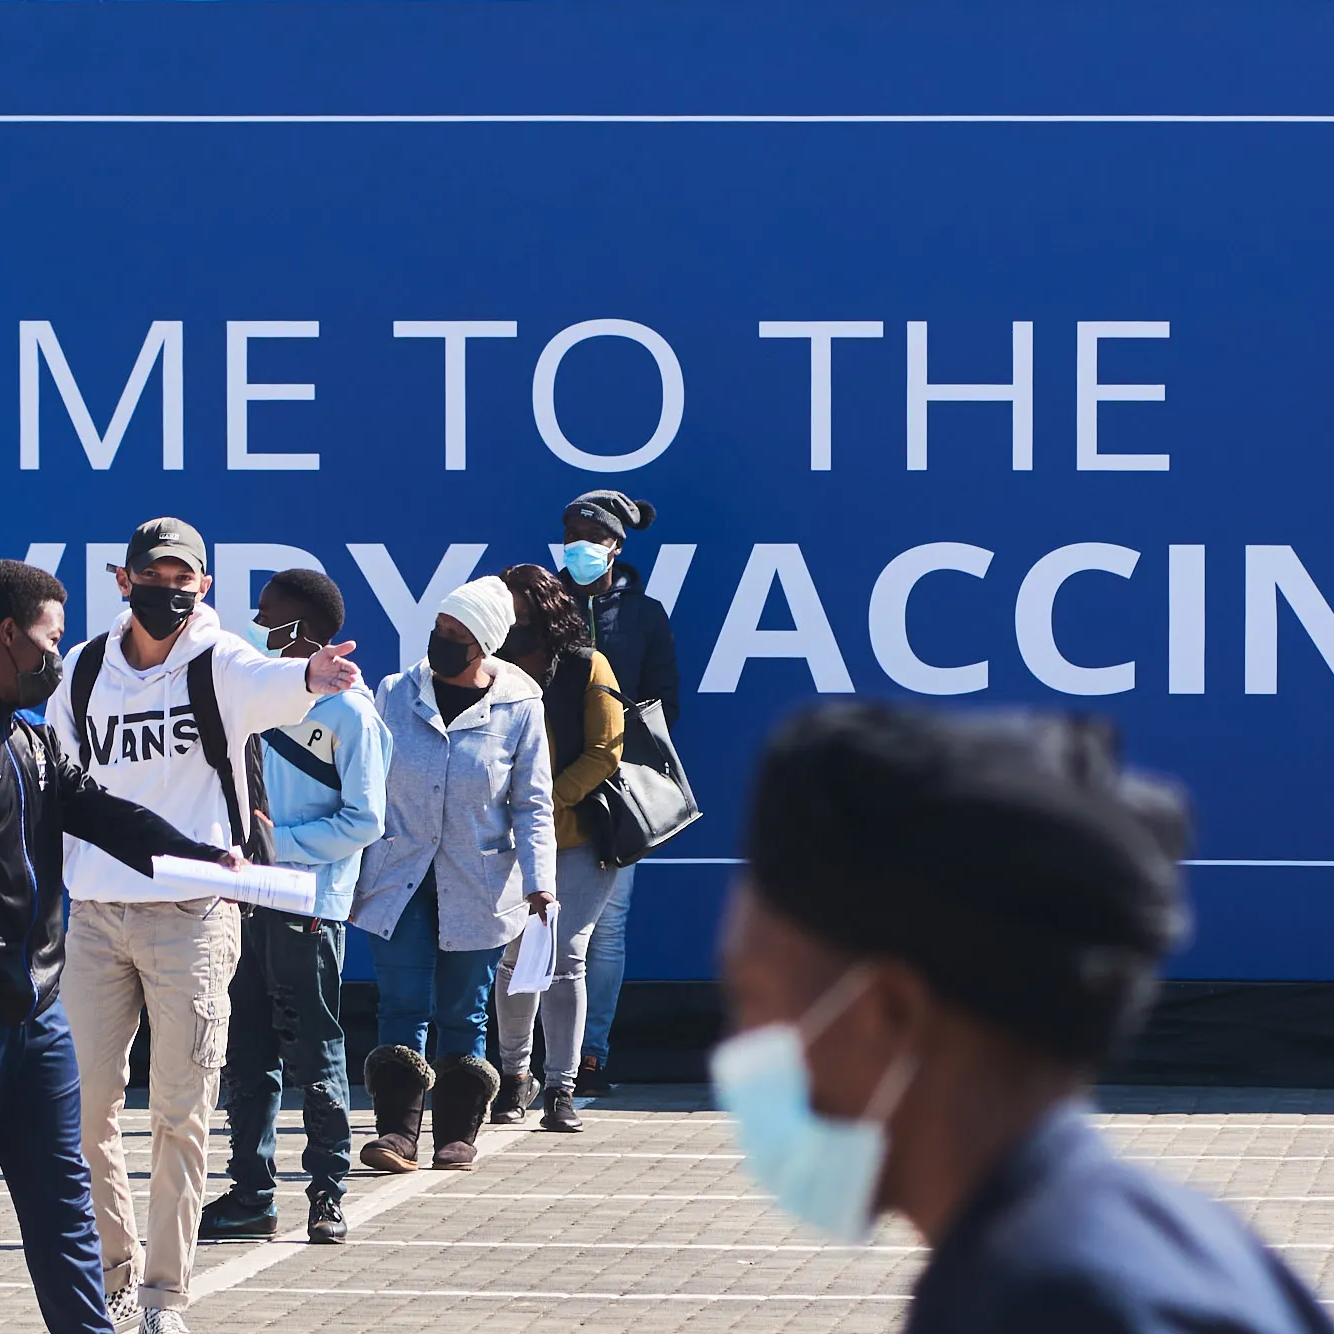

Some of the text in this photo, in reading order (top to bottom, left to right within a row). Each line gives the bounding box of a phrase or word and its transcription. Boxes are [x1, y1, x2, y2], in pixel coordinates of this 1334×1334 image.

[393, 318, 685, 473] TO
[758, 321, 1170, 471] THE
[87, 705, 200, 766] VANS
